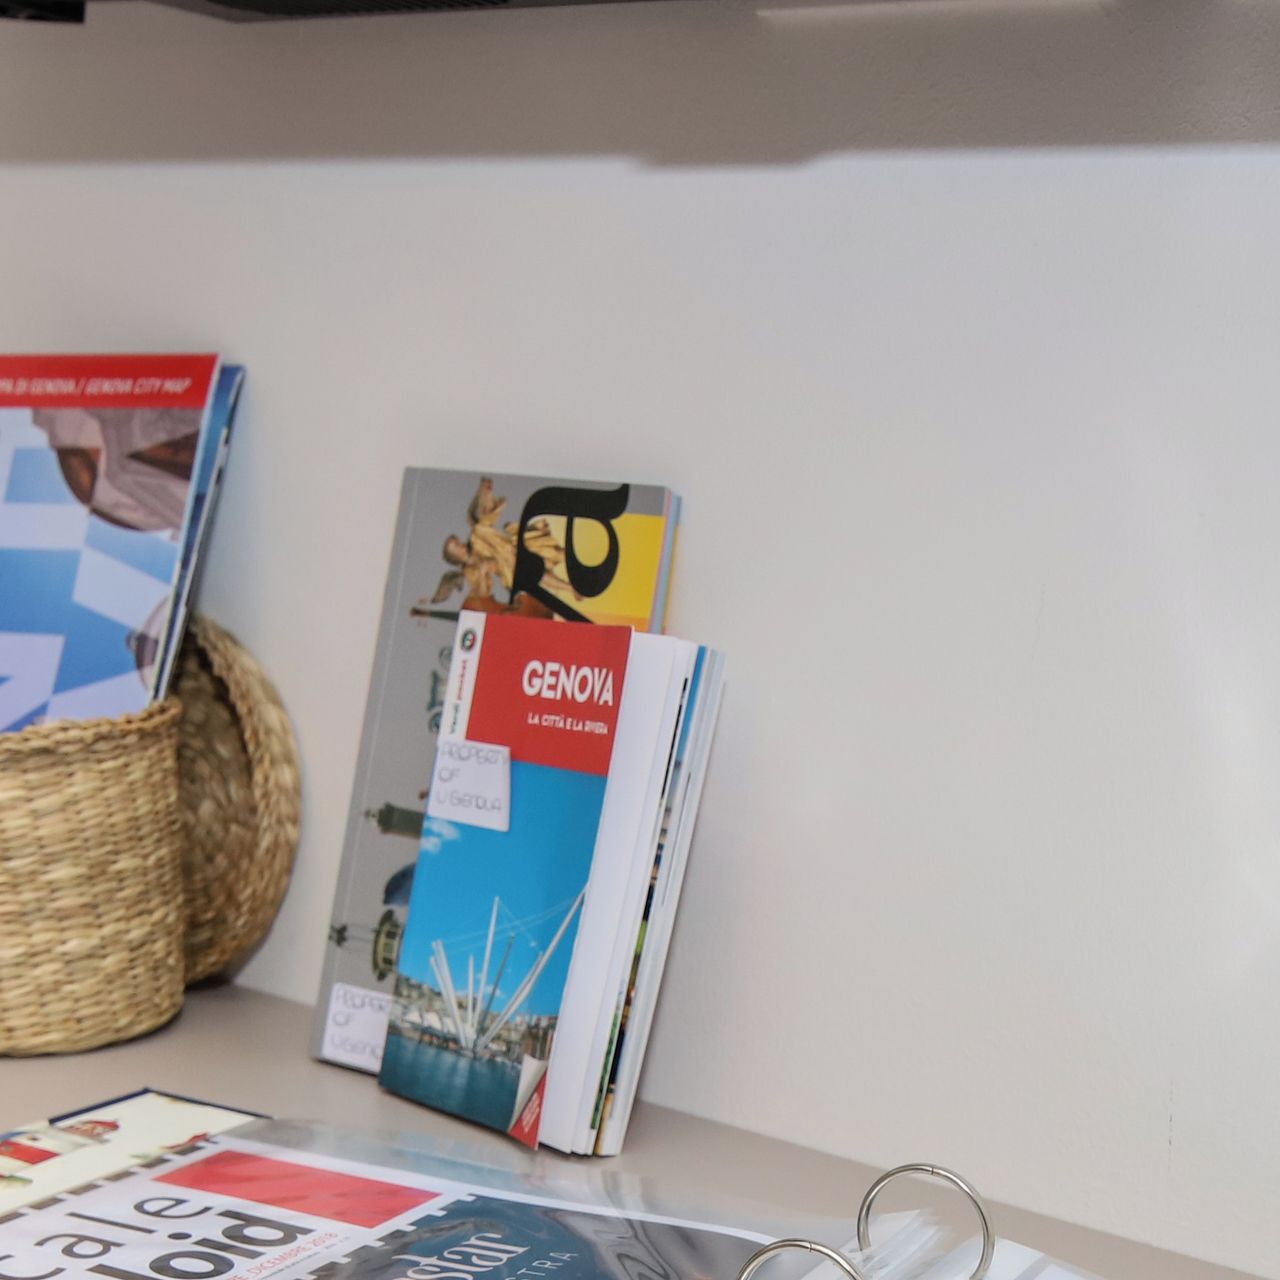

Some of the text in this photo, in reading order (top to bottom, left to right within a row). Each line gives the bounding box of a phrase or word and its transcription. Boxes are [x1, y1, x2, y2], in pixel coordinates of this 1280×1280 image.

[522, 660, 614, 706] GENOVA
[527, 712, 540, 725] LA
[541, 713, 564, 729] CITTÀ
[566, 718, 573, 729] E
[573, 719, 583, 731] LA
